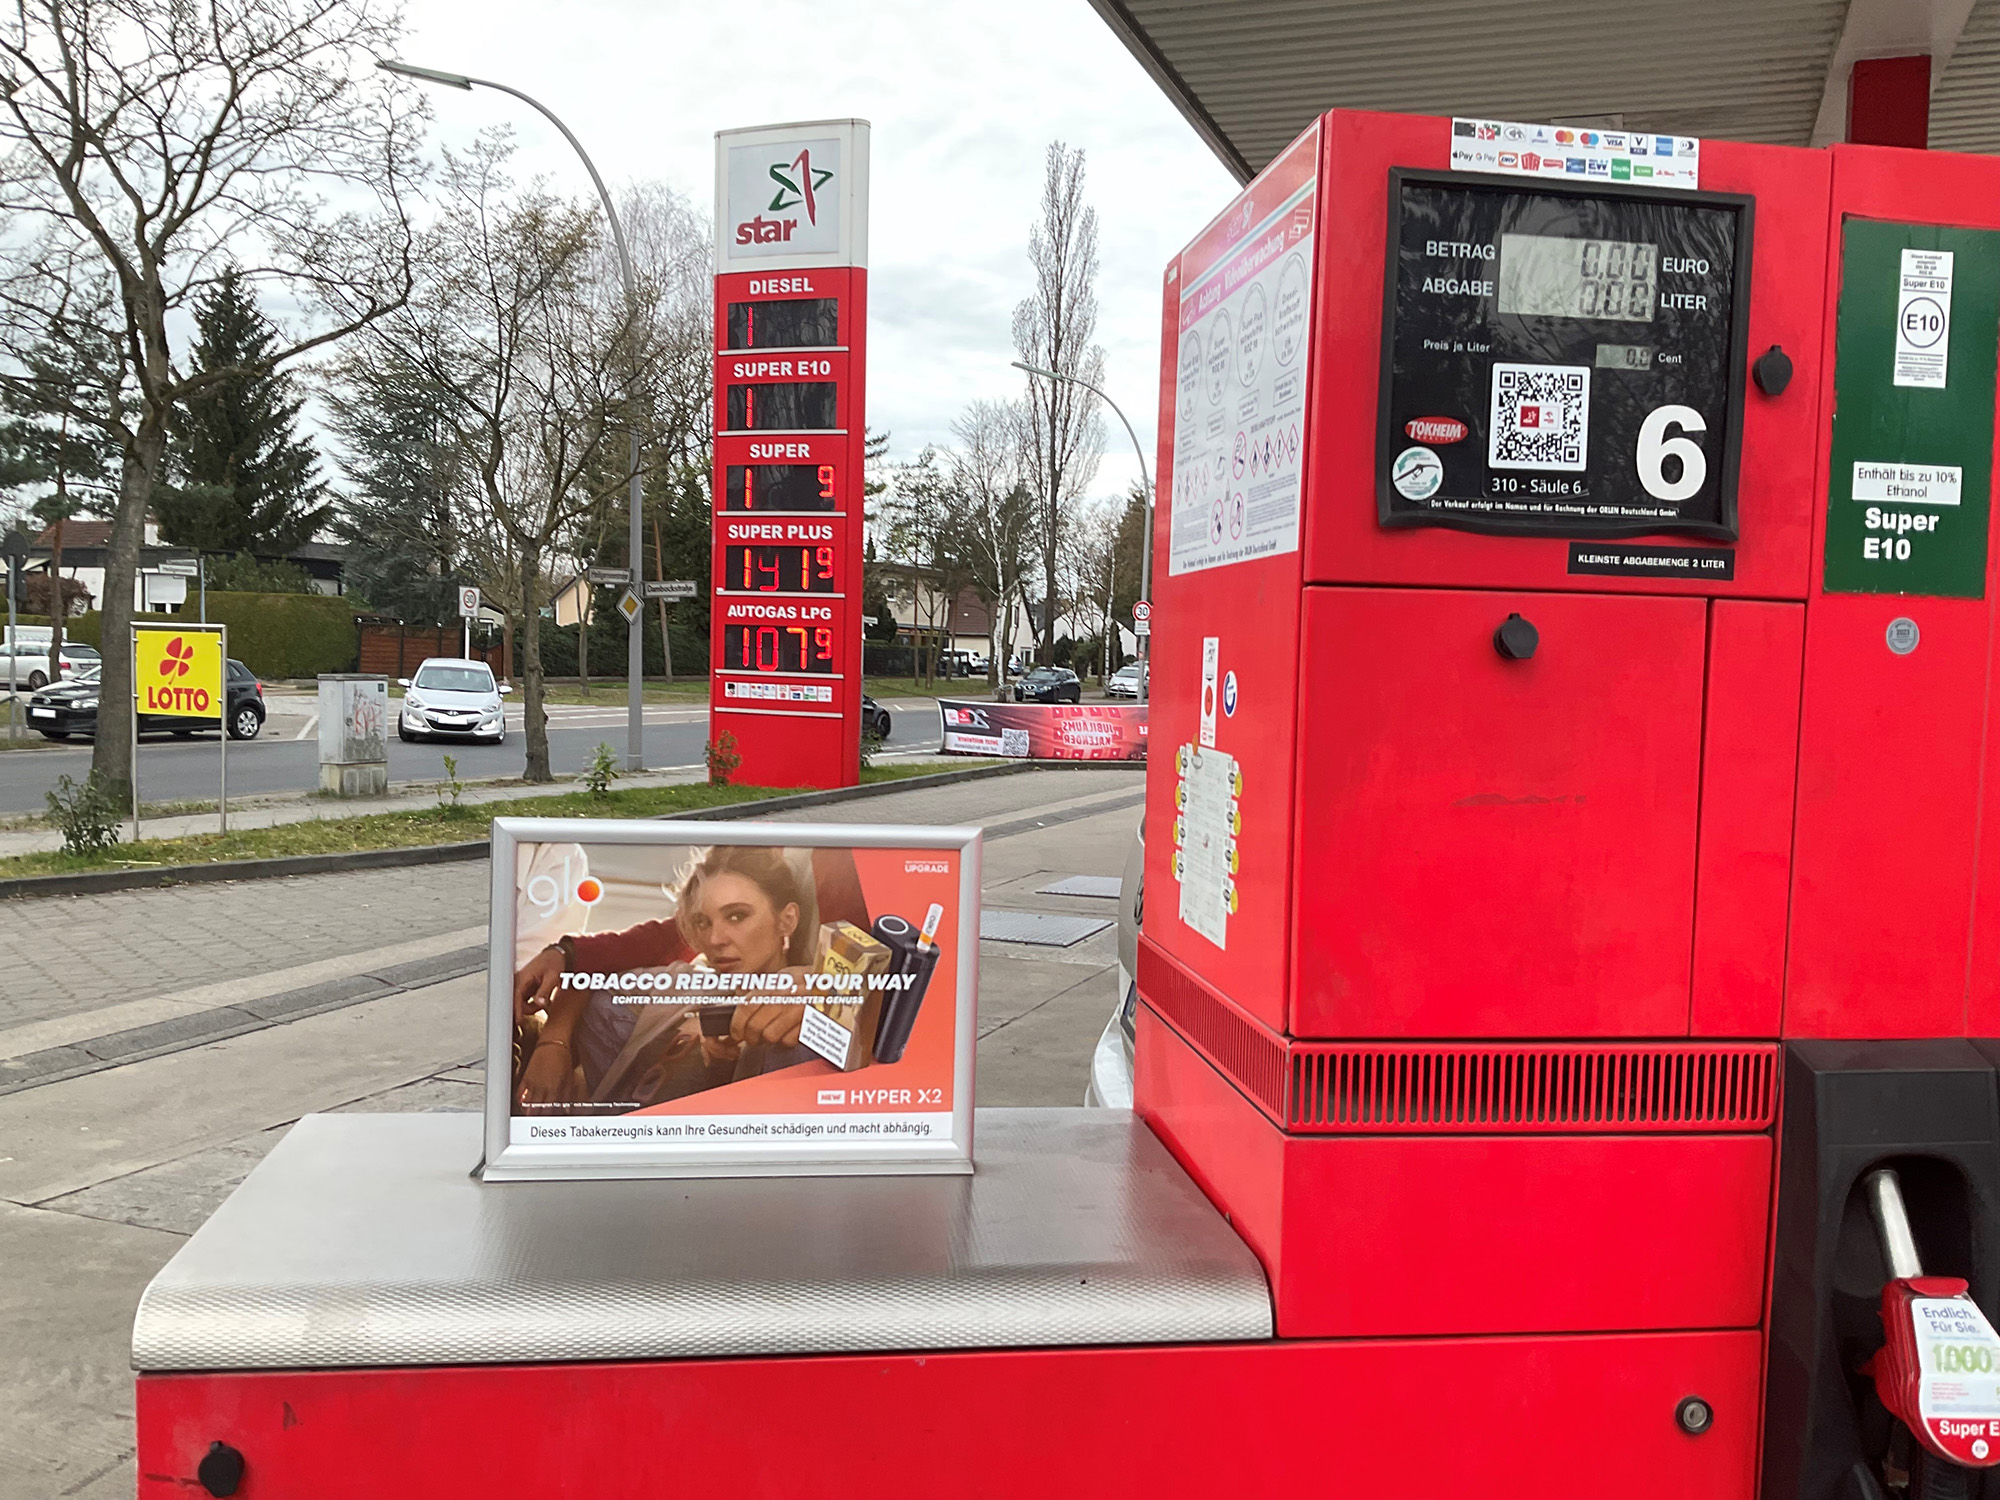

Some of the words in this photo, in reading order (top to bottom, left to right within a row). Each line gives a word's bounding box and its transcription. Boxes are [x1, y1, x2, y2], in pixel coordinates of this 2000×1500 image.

[1606, 139, 1623, 147] VISA
[1459, 152, 1473, 162] Pay
[735, 214, 797, 245] star
[1426, 240, 1496, 260] BETRAG
[1662, 256, 1710, 275] EURO
[750, 278, 814, 295] DIESEL
[1421, 277, 1494, 297] ABGABE
[1903, 278, 1927, 289] Super
[1929, 280, 1946, 290] E10
[1661, 292, 1707, 311] LITER
[1906, 313, 1939, 332] E10
[1423, 338, 1449, 351] Preis
[1453, 340, 1463, 353] je
[1467, 341, 1491, 353] Liter
[1658, 352, 1682, 364] Cent
[733, 362, 792, 378] SUPER
[797, 360, 831, 376] E10
[1407, 420, 1461, 439] TOKHEIM
[749, 443, 810, 459] SUPER
[1636, 404, 1707, 501] 6
[1858, 467, 1896, 481] Enthält
[1900, 469, 1915, 481] bis
[1918, 473, 1932, 482] zu
[1936, 471, 1957, 484] 10%
[1491, 477, 1518, 492] 310
[1530, 477, 1568, 494] Säule
[1572, 480, 1582, 494] 6
[1887, 484, 1928, 498] Ethanol
[1431, 499, 1441, 508] Der
[1444, 500, 1469, 509] Verkauf
[1471, 501, 1493, 511] erfolgt
[1495, 502, 1503, 510] im
[1505, 502, 1527, 511] Namen
[1529, 503, 1541, 511] und
[1543, 503, 1553, 512] für
[1555, 504, 1584, 515] Rechnung
[1586, 505, 1597, 514] der
[1621, 506, 1658, 516] Deutschland
[1865, 507, 1939, 534] Super
[728, 524, 782, 540] SUPER
[787, 524, 833, 540] PLUS
[1864, 537, 1911, 560] E10
[1577, 553, 1620, 564] KLEINSTE
[1623, 556, 1690, 568] ABGABEMENGE
[1692, 559, 1699, 568] 2
[1701, 559, 1726, 569] LITER
[727, 604, 797, 619] AUTOGAS
[801, 606, 832, 620] LPG
[1136, 606, 1149, 617] 30
[148, 686, 209, 712] LOTTO
[905, 864, 949, 873] UPGRADE
[527, 855, 605, 919] glo
[560, 973, 672, 990] TOBACCO
[675, 973, 798, 993] REDEFINED,
[804, 973, 864, 991] YOUR
[867, 973, 917, 991] WAY
[612, 996, 651, 1005] ECHTER
[652, 996, 748, 1006] TABAKGESCHMACK,
[750, 996, 825, 1005] ABGERUNDETER
[826, 996, 864, 1005] GENUSS
[821, 1093, 842, 1101] NEW
[850, 1089, 911, 1105] HYPER
[917, 1088, 942, 1104] X2
[530, 1126, 567, 1138] Dieses
[571, 1125, 653, 1139] Tabakerzeugnis
[656, 1125, 682, 1136] kann
[685, 1124, 705, 1136] Ihre
[708, 1123, 768, 1136] Gesundheit
[771, 1123, 823, 1137] schädigen
[827, 1123, 846, 1134] und
[849, 1123, 880, 1134] macht
[883, 1122, 932, 1136] abhängig.
[1922, 1307, 1976, 1319] Endlich.
[1930, 1321, 1952, 1332] Für
[1954, 1321, 1981, 1334] Sie.
[1939, 1419, 1986, 1440] Super
